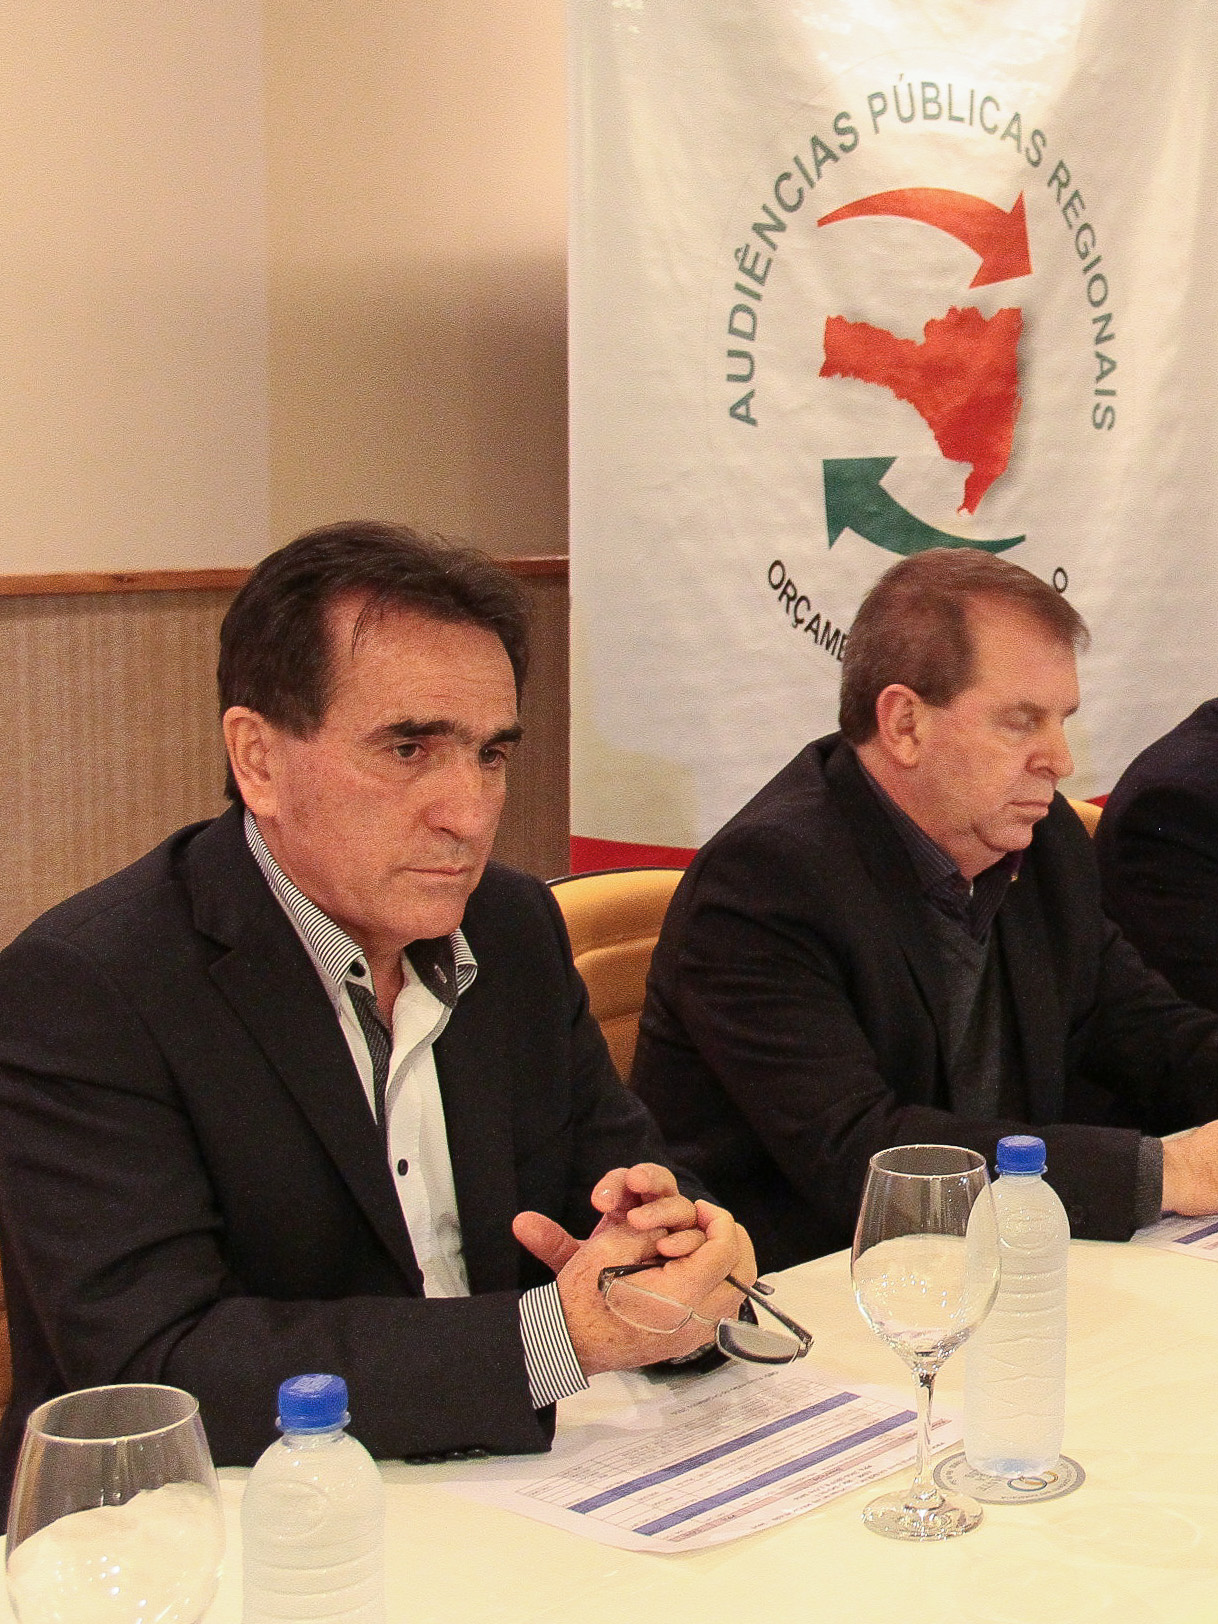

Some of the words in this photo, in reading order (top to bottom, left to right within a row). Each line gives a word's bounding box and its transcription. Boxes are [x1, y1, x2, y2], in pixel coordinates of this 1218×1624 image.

[726, 110, 859, 426] AUDIÊNCIAS
[867, 74, 1047, 168] PÚBLICAS
[1047, 160, 1117, 431] REGIONAIS
[767, 559, 848, 662] ORÇAME
